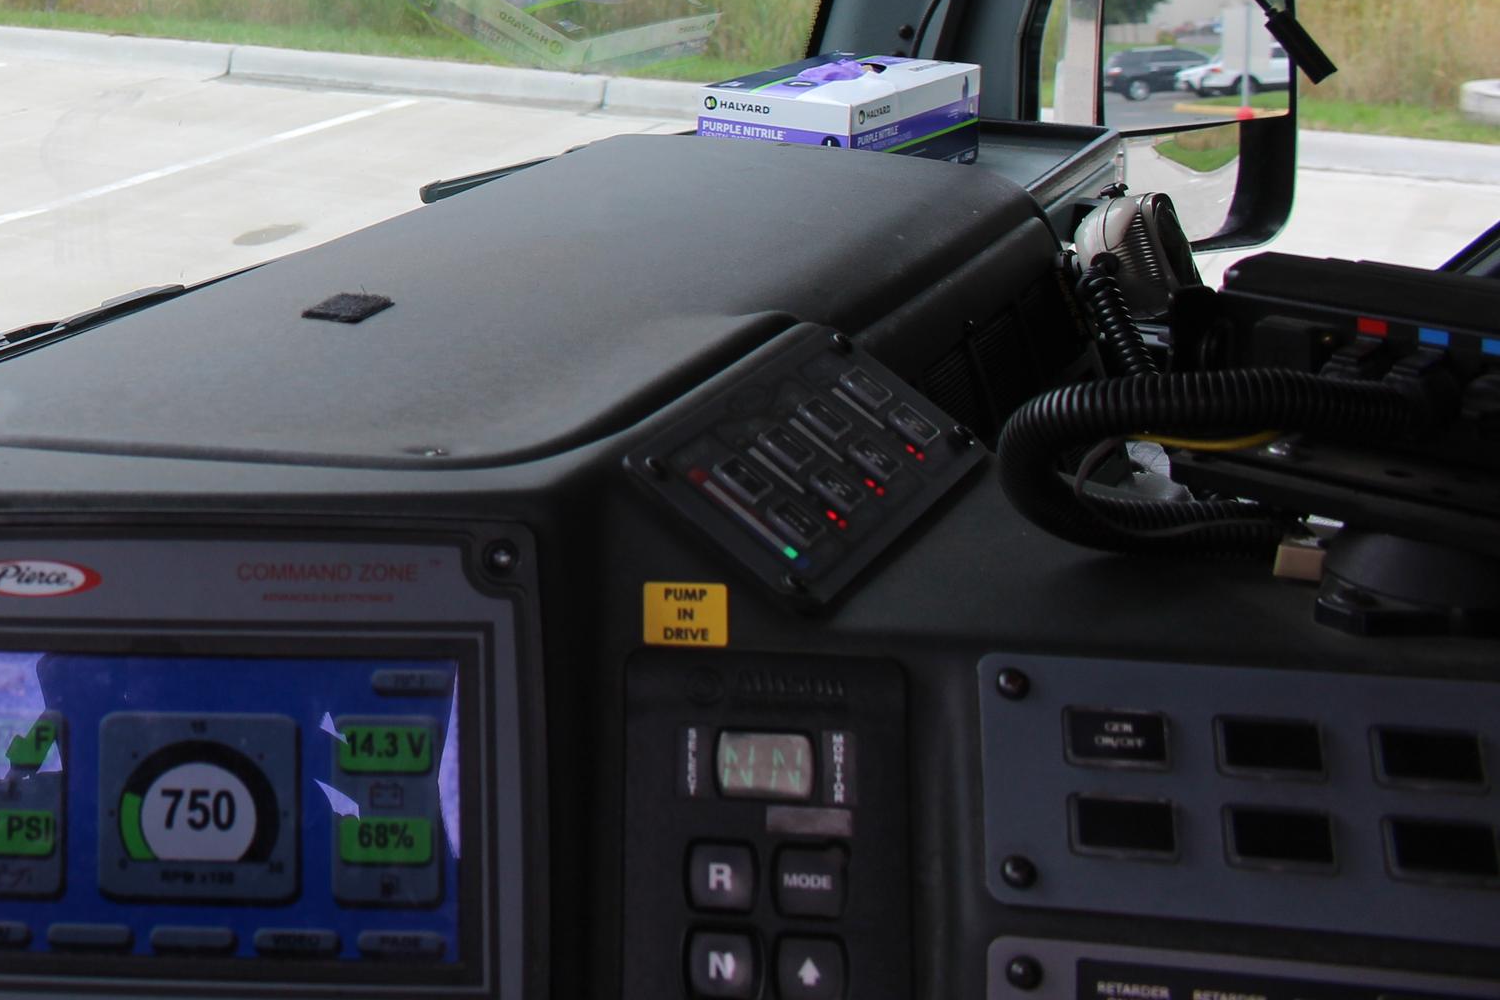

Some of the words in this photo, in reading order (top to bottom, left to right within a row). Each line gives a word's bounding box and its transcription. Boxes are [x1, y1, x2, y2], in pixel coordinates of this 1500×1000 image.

[720, 100, 770, 115] HALYARD
[866, 104, 891, 119] HALYARD
[702, 119, 742, 135] PURPLE
[743, 125, 784, 141] NITRILE
[857, 131, 879, 147] PURPLE
[879, 125, 899, 140] NITRILE
[237, 561, 352, 583] COMMAND
[359, 562, 418, 583] ZONE
[664, 588, 707, 601] PUMP
[677, 607, 694, 621] IN
[663, 627, 708, 641] DRIVE
[348, 731, 399, 758] 14.3
[406, 733, 426, 758] V
[832, 733, 844, 804] MONITOR
[161, 789, 237, 831] 750
[6, 814, 52, 841] PSI
[358, 821, 414, 850] 68%
[160, 871, 194, 884] RPM
[708, 861, 733, 891] R
[783, 872, 833, 891] MODE
[272, 933, 321, 947] VIDEO
[380, 935, 422, 948] PAGE
[708, 950, 735, 981] N
[1097, 981, 1171, 999] RETARDER
